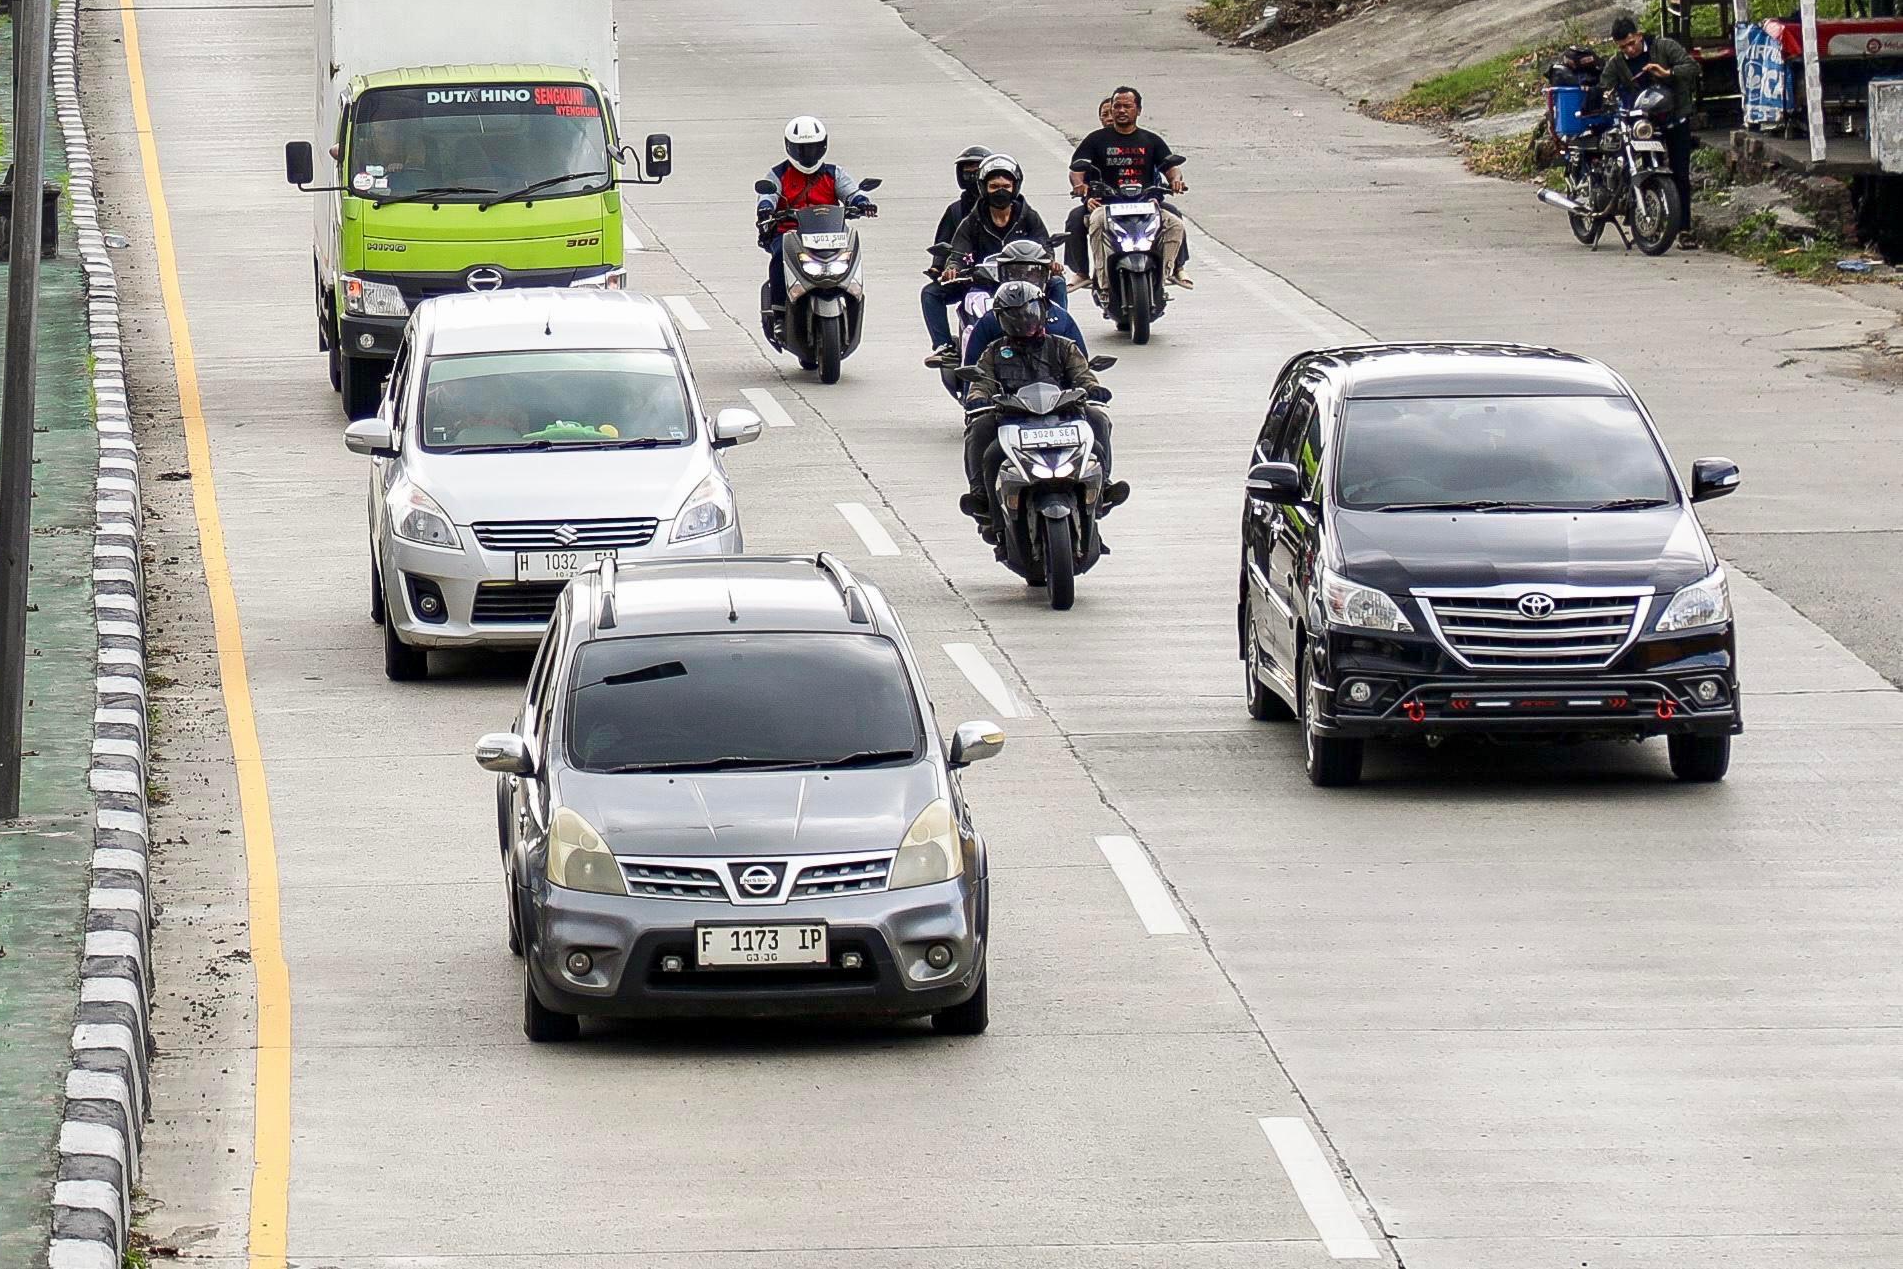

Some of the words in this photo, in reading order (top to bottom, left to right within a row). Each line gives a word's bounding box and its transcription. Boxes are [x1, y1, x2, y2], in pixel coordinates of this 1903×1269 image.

[427, 89, 478, 104] DUTA
[480, 89, 531, 103] HINO
[555, 105, 598, 117] NYENGKUNI
[366, 243, 407, 252] HINO
[566, 237, 599, 248] 300
[520, 555, 529, 570] H
[545, 554, 577, 570] 1032
[702, 931, 712, 952] F
[731, 930, 778, 951] 1173
[799, 929, 822, 950] IP
